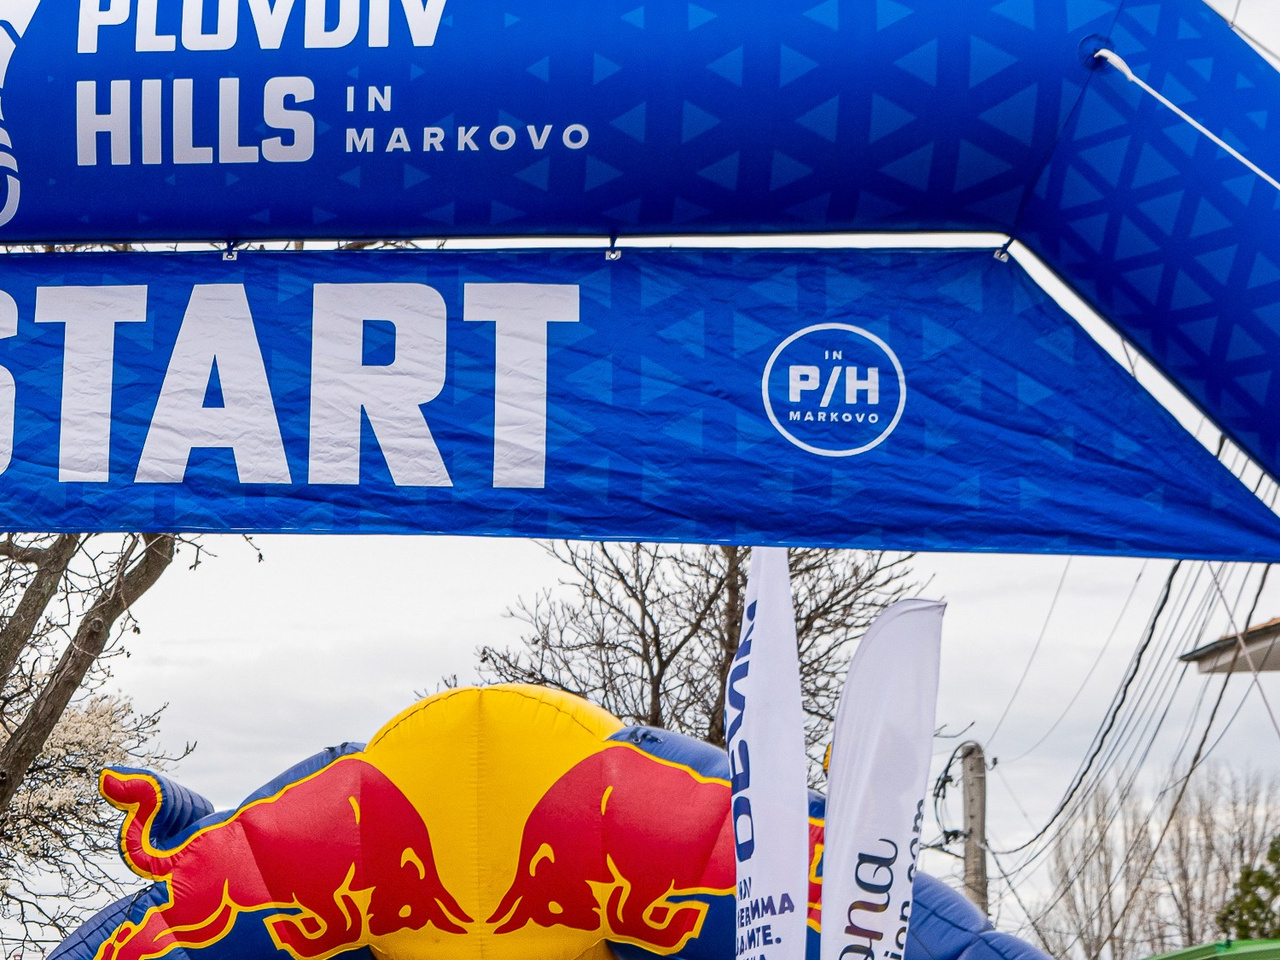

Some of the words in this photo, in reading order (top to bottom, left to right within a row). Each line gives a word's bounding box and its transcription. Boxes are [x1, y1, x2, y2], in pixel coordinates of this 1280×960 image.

[77, 0, 447, 54] PLOVDIV
[347, 86, 391, 113] IN
[76, 76, 316, 166] HILLS
[346, 124, 590, 153] MARKOVO
[824, 350, 842, 360] IN
[789, 365, 879, 408] P/H
[789, 411, 880, 424] MARKOVO
